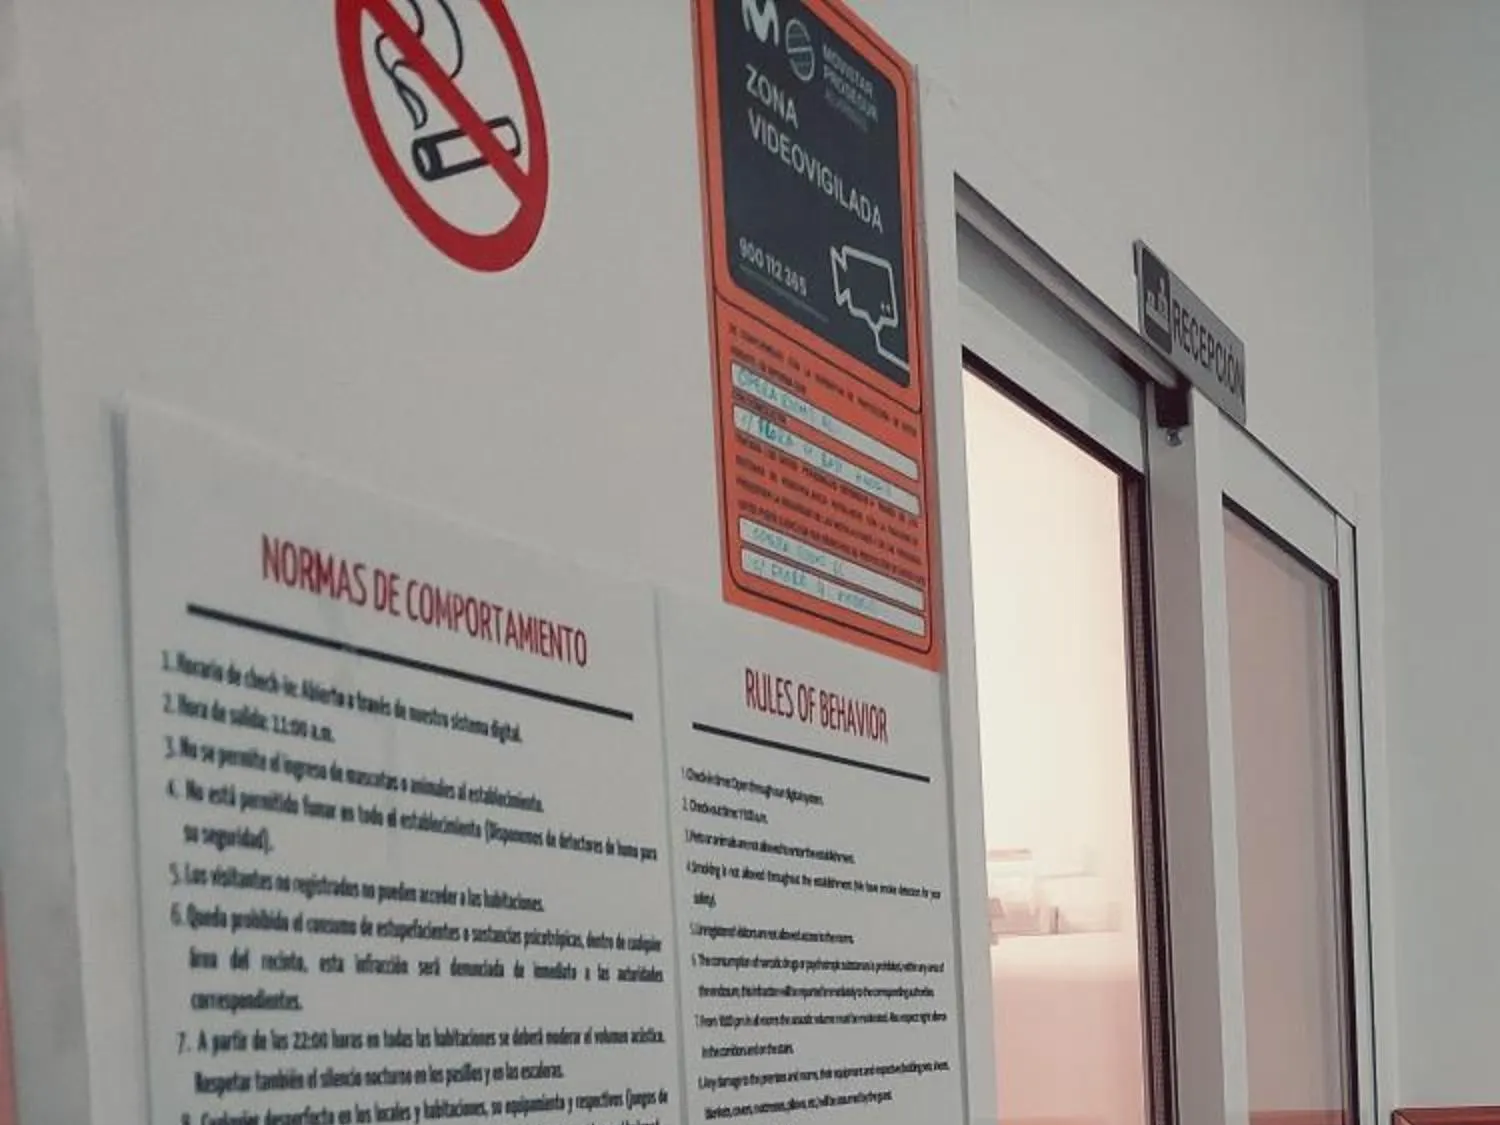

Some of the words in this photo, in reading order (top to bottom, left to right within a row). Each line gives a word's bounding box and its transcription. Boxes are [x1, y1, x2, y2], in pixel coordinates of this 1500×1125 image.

[745, 63, 799, 129] ZONA
[748, 107, 884, 234] VIDEOVIGILADA
[1172, 299, 1246, 403] RECEPCIÓN
[261, 533, 367, 607] NORMAS
[373, 567, 399, 617] DE
[405, 579, 587, 668] COMPORTAMIENTO
[744, 667, 795, 719] RULES
[797, 683, 816, 724] OF
[818, 689, 888, 743] BEHAVIOR
